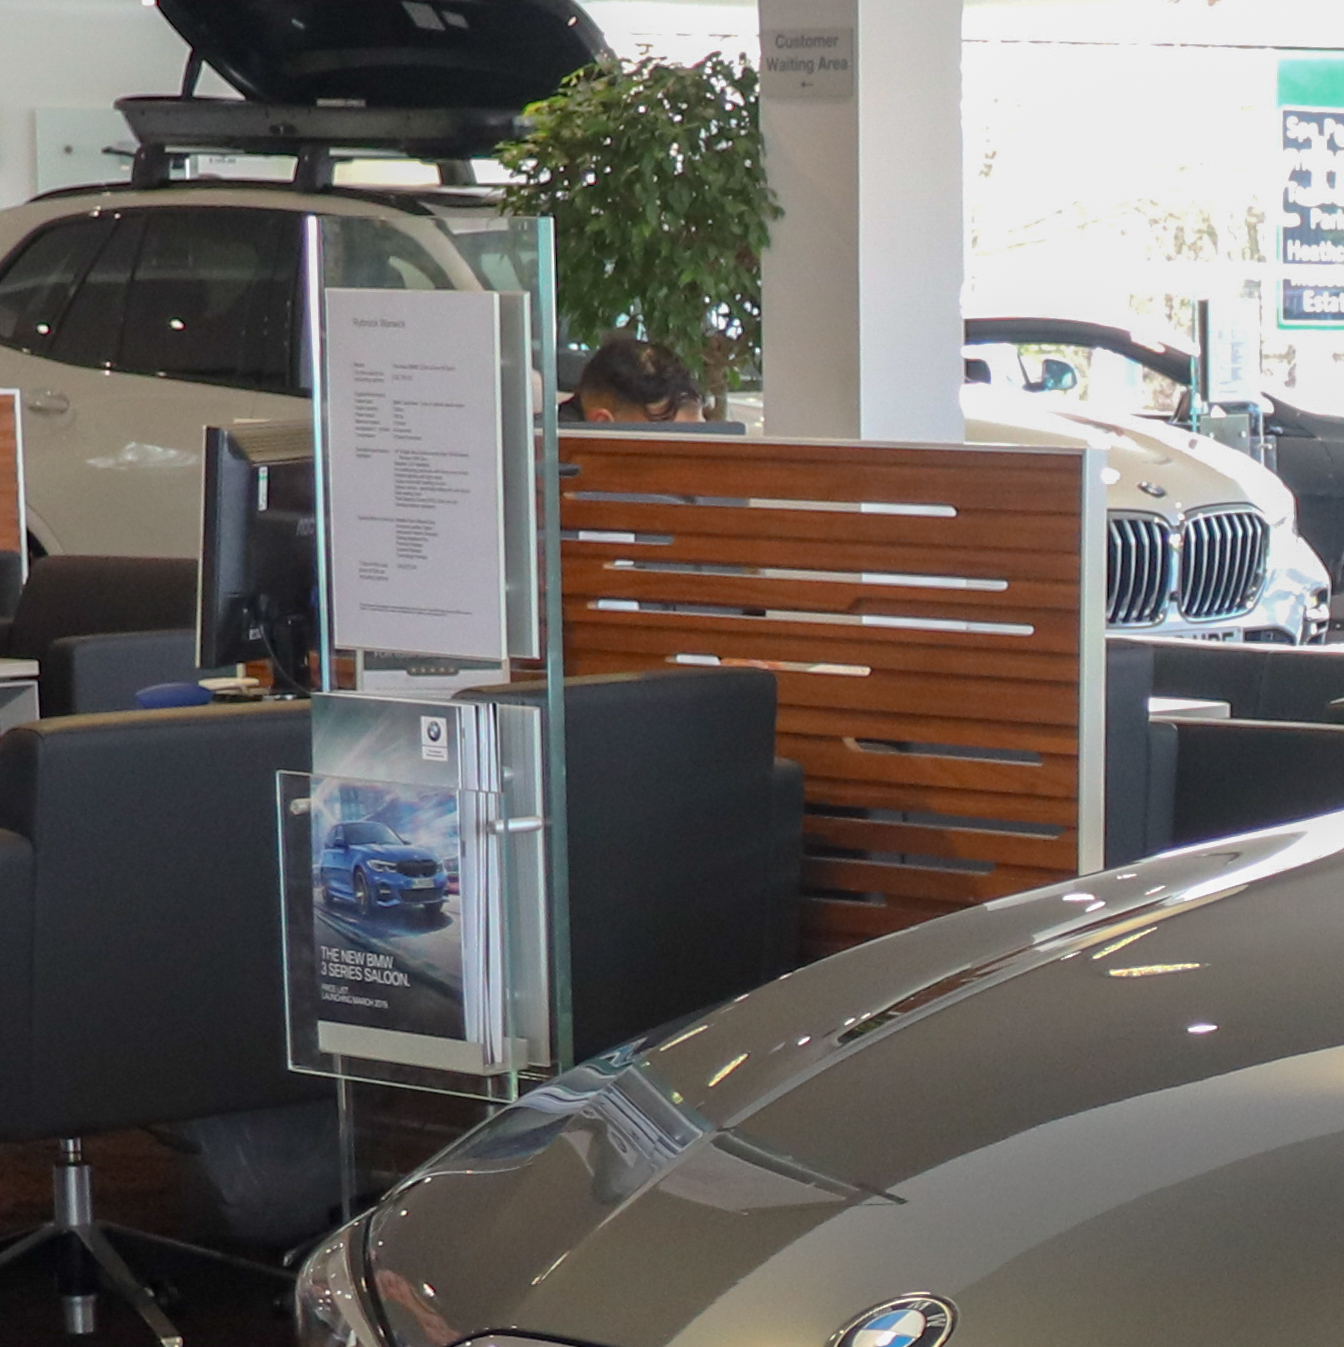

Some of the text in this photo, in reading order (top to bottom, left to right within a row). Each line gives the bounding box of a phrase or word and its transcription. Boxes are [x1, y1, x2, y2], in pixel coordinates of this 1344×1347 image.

[775, 33, 839, 49] Customer
[766, 56, 849, 75] Waiting Area
[321, 945, 395, 970] THE NEW BMW
[320, 961, 412, 988] 3 SERIES SALOON.
